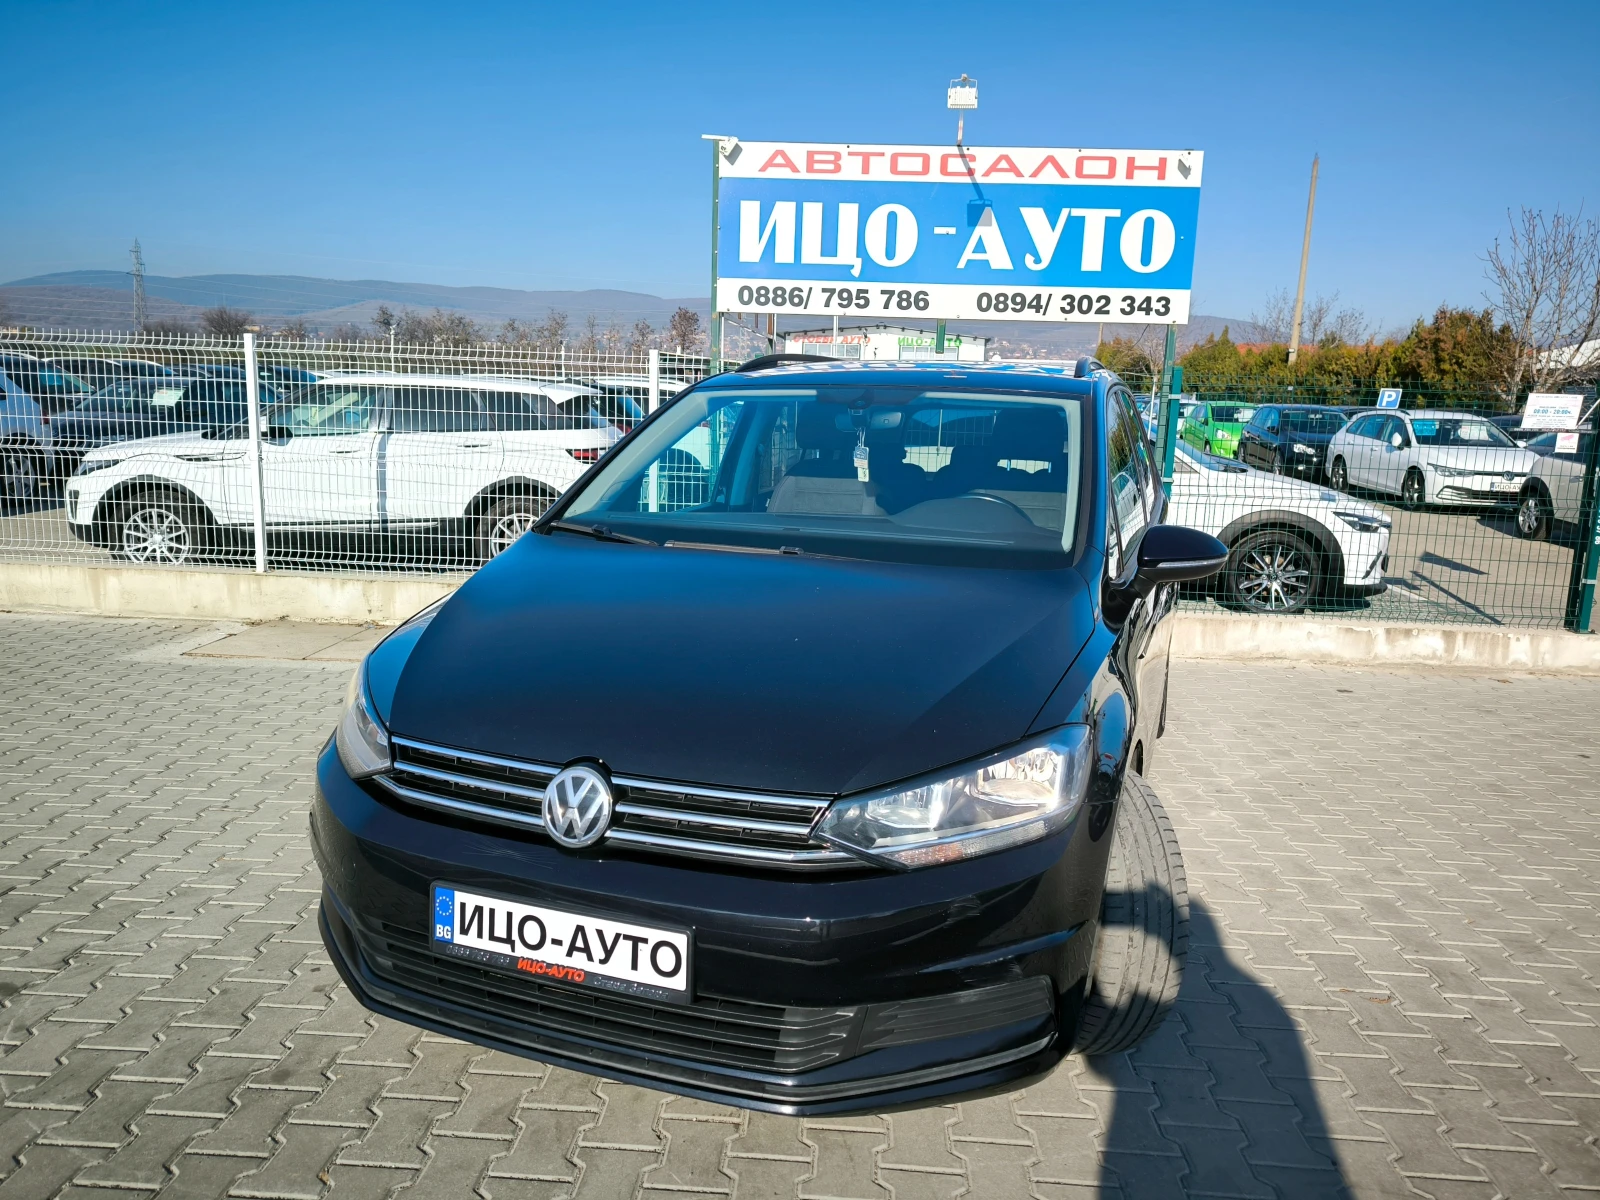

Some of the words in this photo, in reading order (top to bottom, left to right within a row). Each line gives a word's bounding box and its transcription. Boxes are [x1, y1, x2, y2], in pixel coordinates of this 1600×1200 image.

[757, 149, 1168, 181] АВТОСАЛОН
[737, 285, 813, 310] 0886/
[821, 288, 871, 310] 795
[880, 289, 930, 312] 786
[976, 291, 1053, 316] 0894/
[1060, 294, 1111, 317] 302
[1120, 296, 1172, 317] 343
[898, 337, 963, 347] ИЦО-АТО
[1381, 391, 1397, 406] P
[436, 924, 451, 940] BG
[459, 902, 682, 978] ИЦО-АУТО
[517, 956, 586, 983] ИЦО-АУТО
